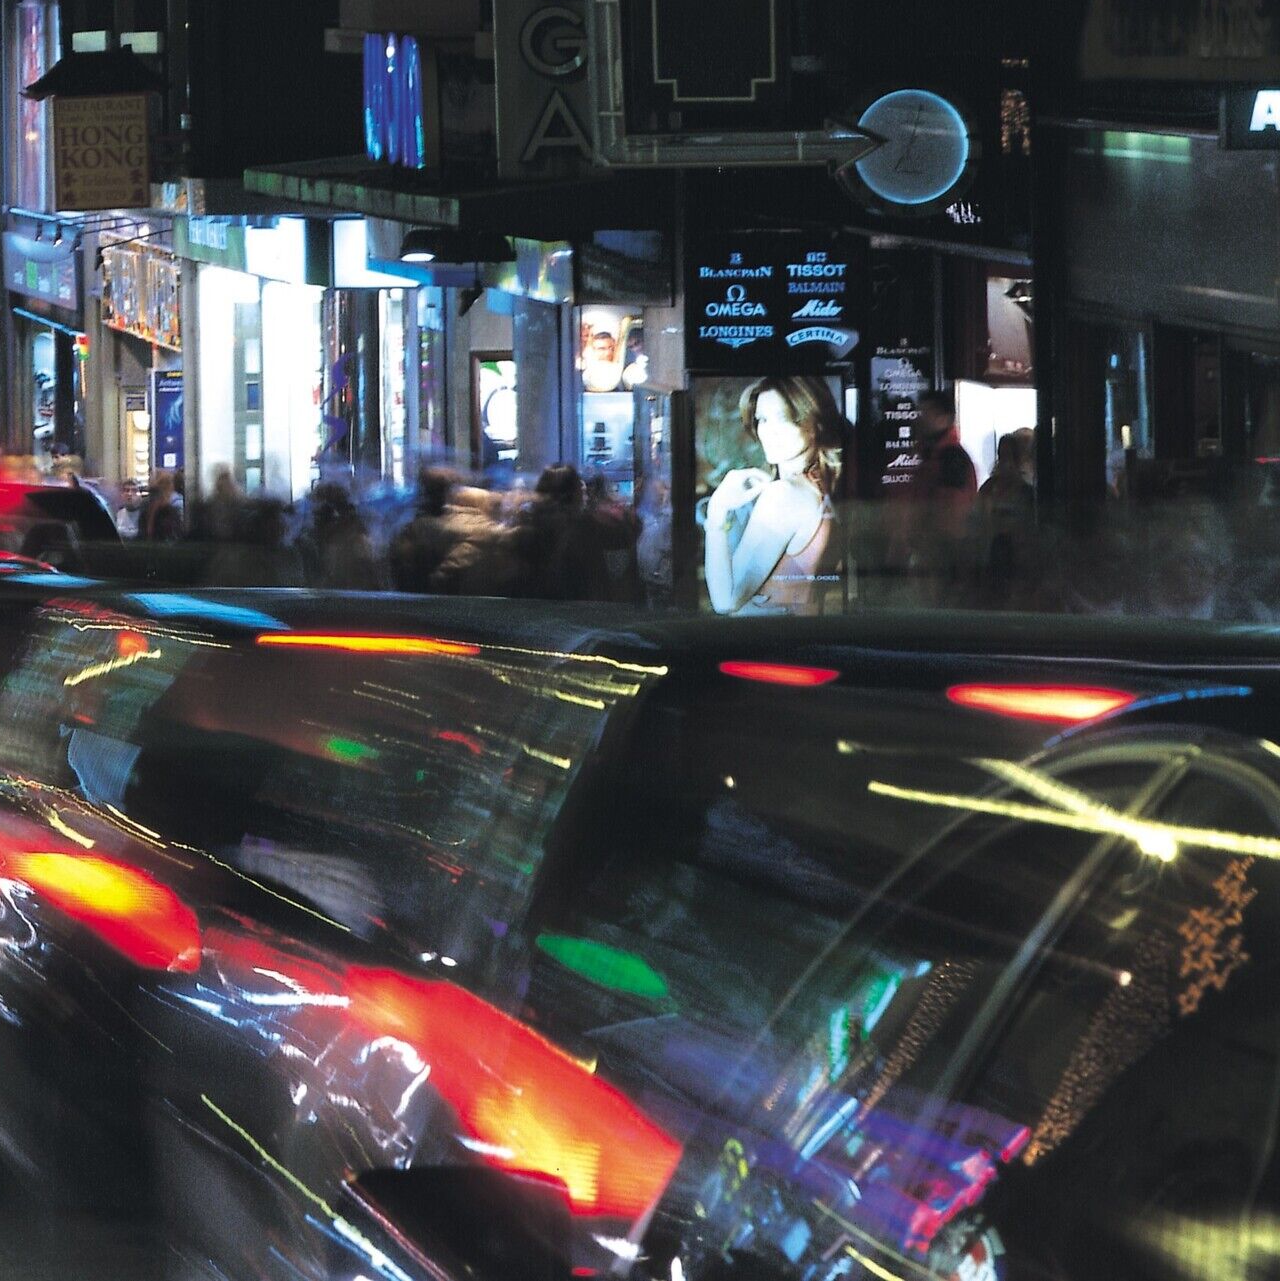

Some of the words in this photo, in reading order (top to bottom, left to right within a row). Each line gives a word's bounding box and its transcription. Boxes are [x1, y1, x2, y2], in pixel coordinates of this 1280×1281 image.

[60, 124, 144, 146] HONG
[60, 146, 144, 169] KONG
[699, 265, 774, 278] BLANCPAIN
[786, 263, 847, 277] TISSOT
[787, 281, 846, 294] BALMAIN
[705, 302, 767, 317] OMEGA
[791, 298, 844, 318] Mido
[699, 324, 774, 338] LONGINES
[788, 328, 845, 345] CERTINA
